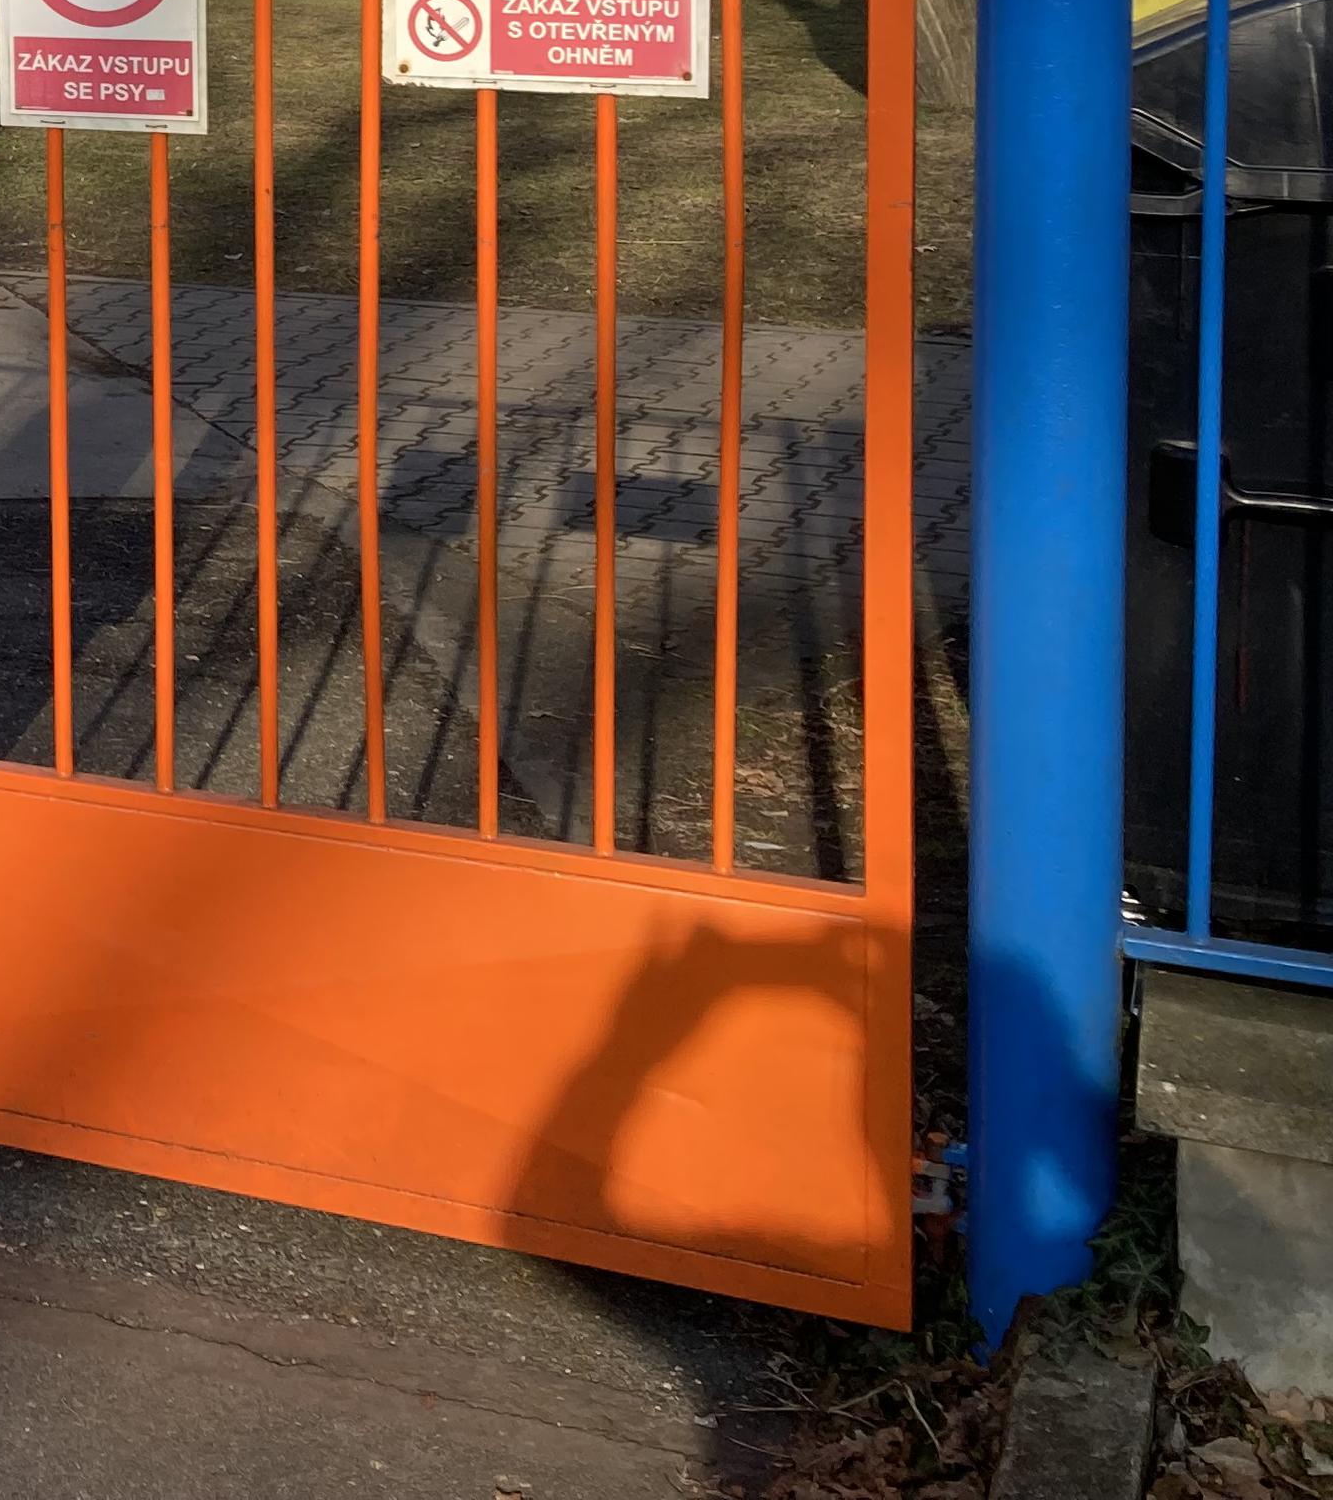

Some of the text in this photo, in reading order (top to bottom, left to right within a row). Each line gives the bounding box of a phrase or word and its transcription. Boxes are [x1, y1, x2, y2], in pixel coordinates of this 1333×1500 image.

[507, 20, 675, 43] S OTEVŘENÝM
[17, 50, 190, 76] ZÁKAZ VSTUPU
[548, 44, 633, 66] OHNĚM
[64, 82, 145, 102] SE PSY
